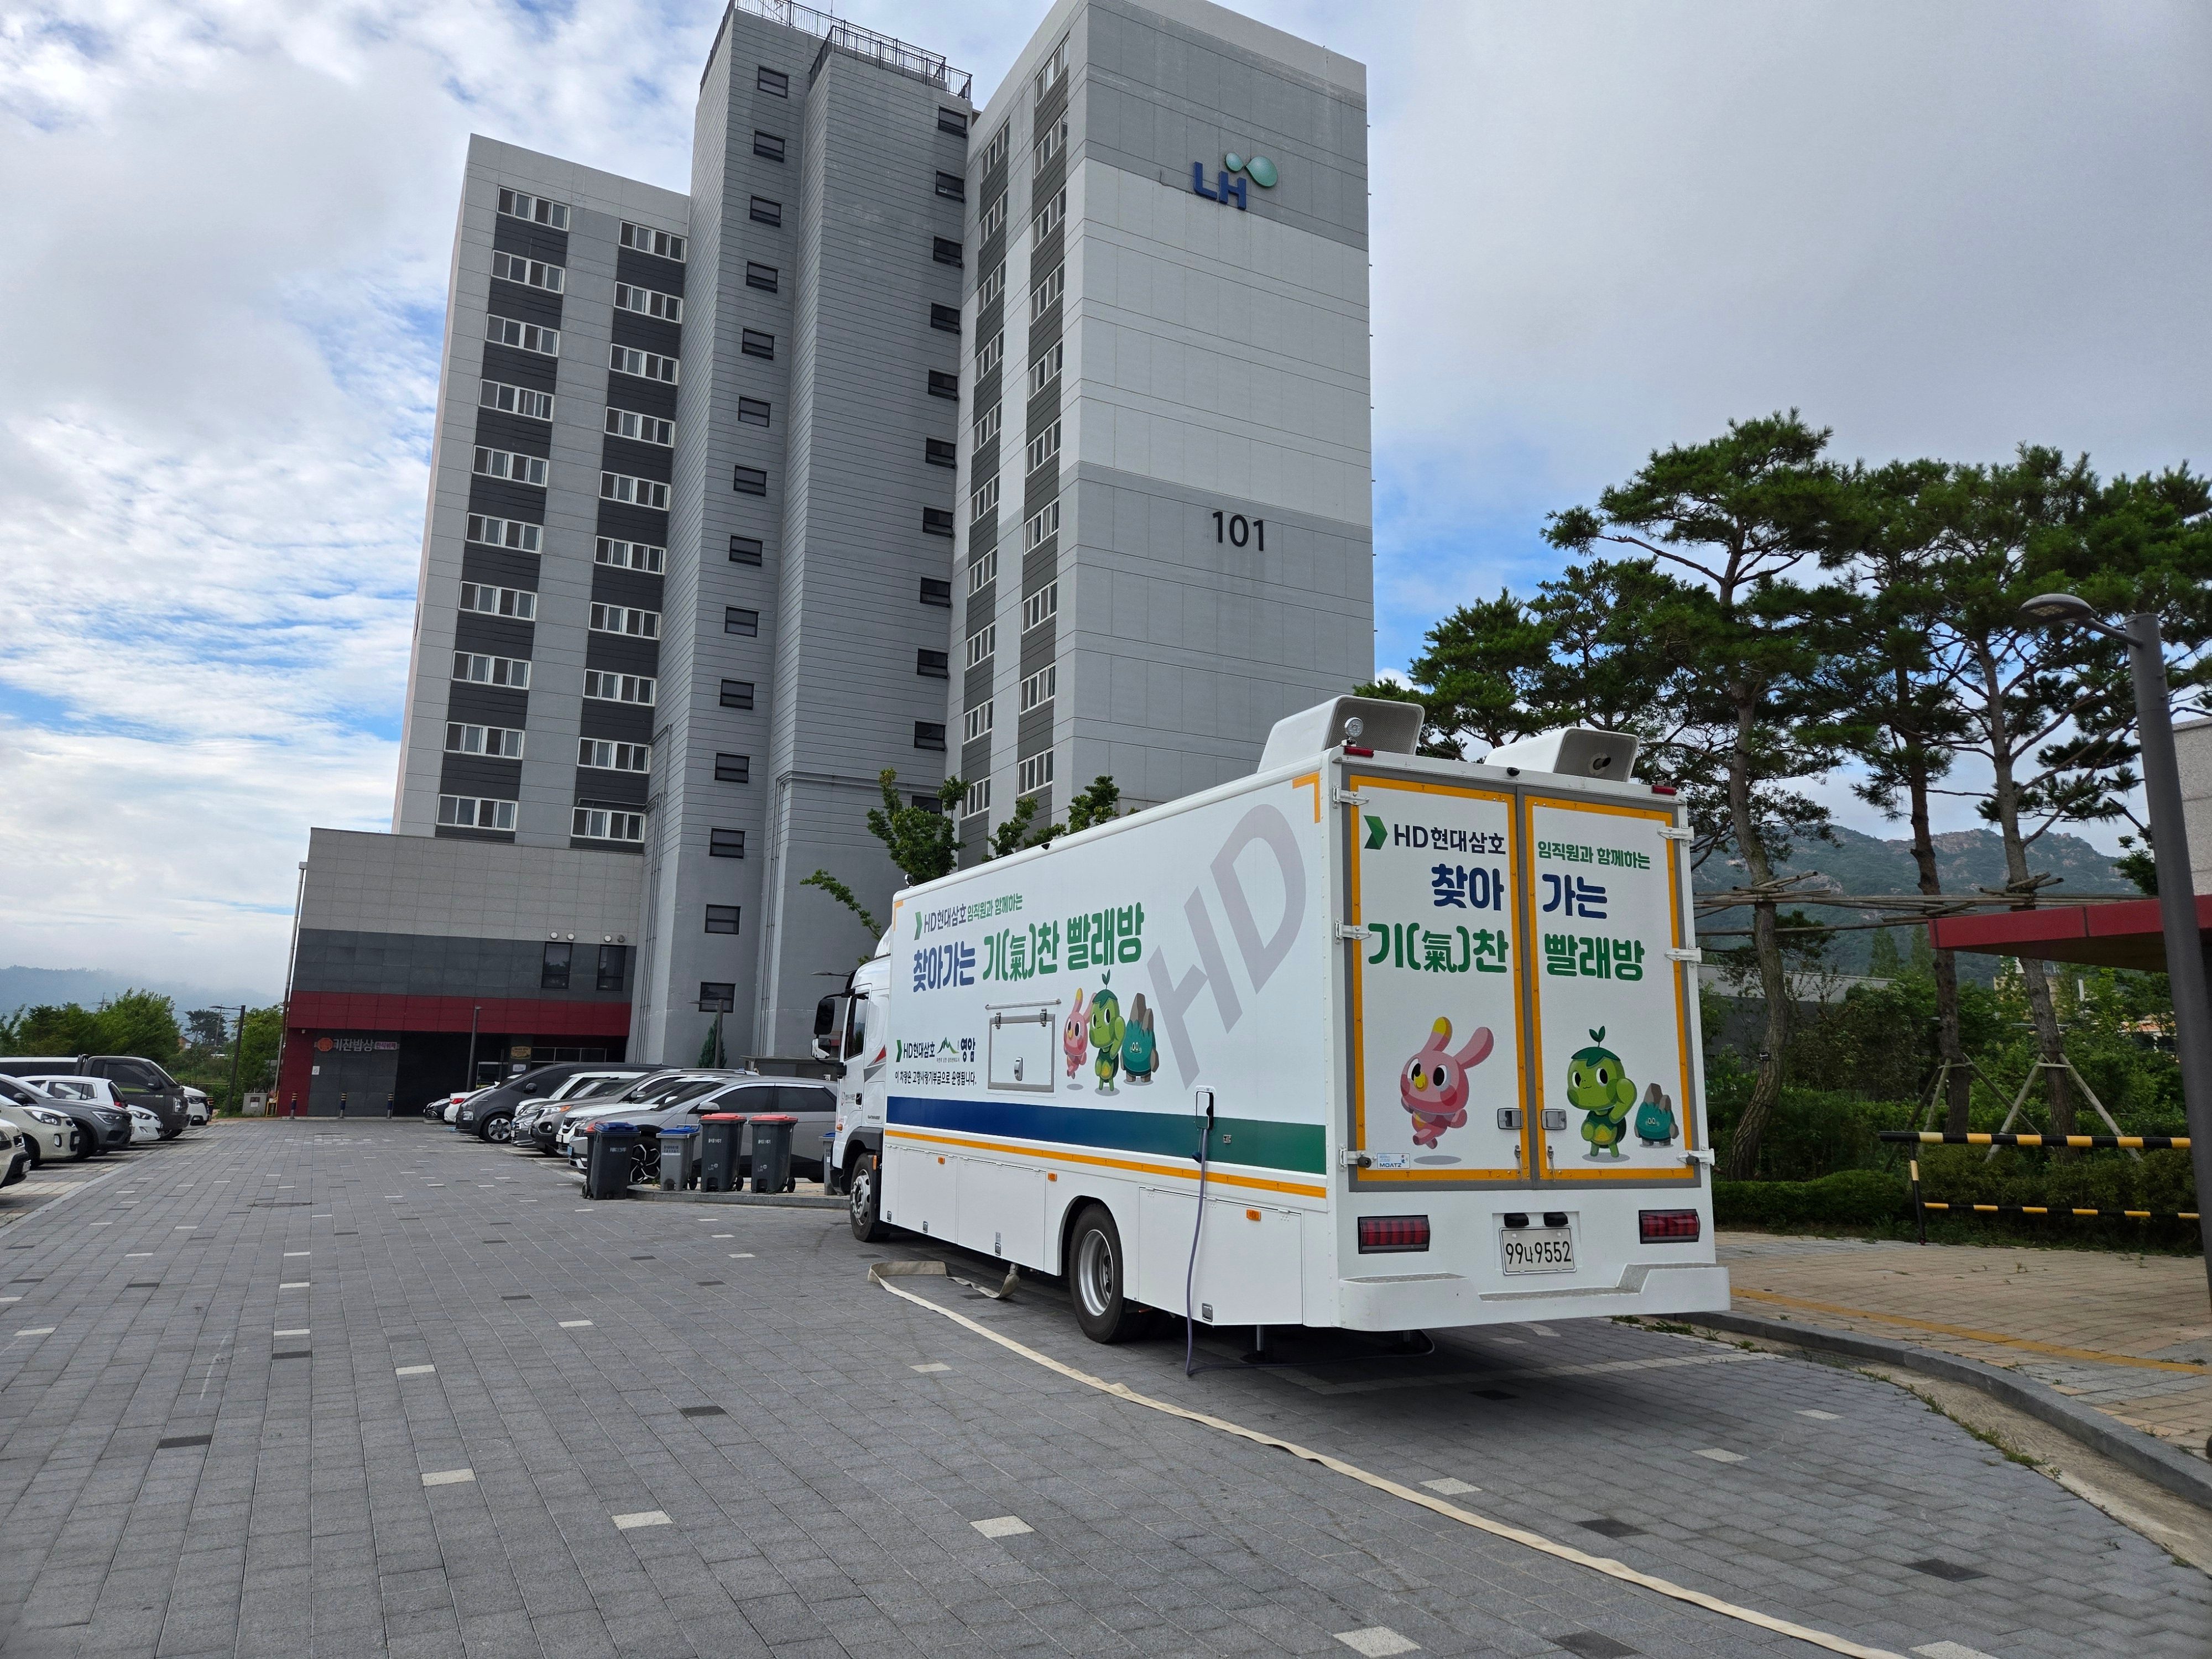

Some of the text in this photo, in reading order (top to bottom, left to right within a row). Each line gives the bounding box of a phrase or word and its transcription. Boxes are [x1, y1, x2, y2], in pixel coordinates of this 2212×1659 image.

[1194, 161, 1246, 210] LH
[1213, 511, 1264, 551] 101
[1394, 823, 1651, 870] HD현대삼호 임직원과 함께하는
[968, 899, 993, 922] 임직원과
[995, 893, 1022, 916] 함께하는
[1431, 863, 1607, 919] 찾아 가는
[913, 902, 1144, 993] 찾아가는 기(氣)찬 빨래방
[1147, 804, 1306, 1091] HD
[1368, 922, 1645, 981] 기(氣)찬 빨래방
[333, 1039, 374, 1051] 기찬밥상
[961, 1037, 975, 1062] 영암
[895, 1071, 977, 1086] 이 차량은 고향사랑기부금으로 운영됩니다.
[1506, 1241, 1572, 1264] 99나9552
